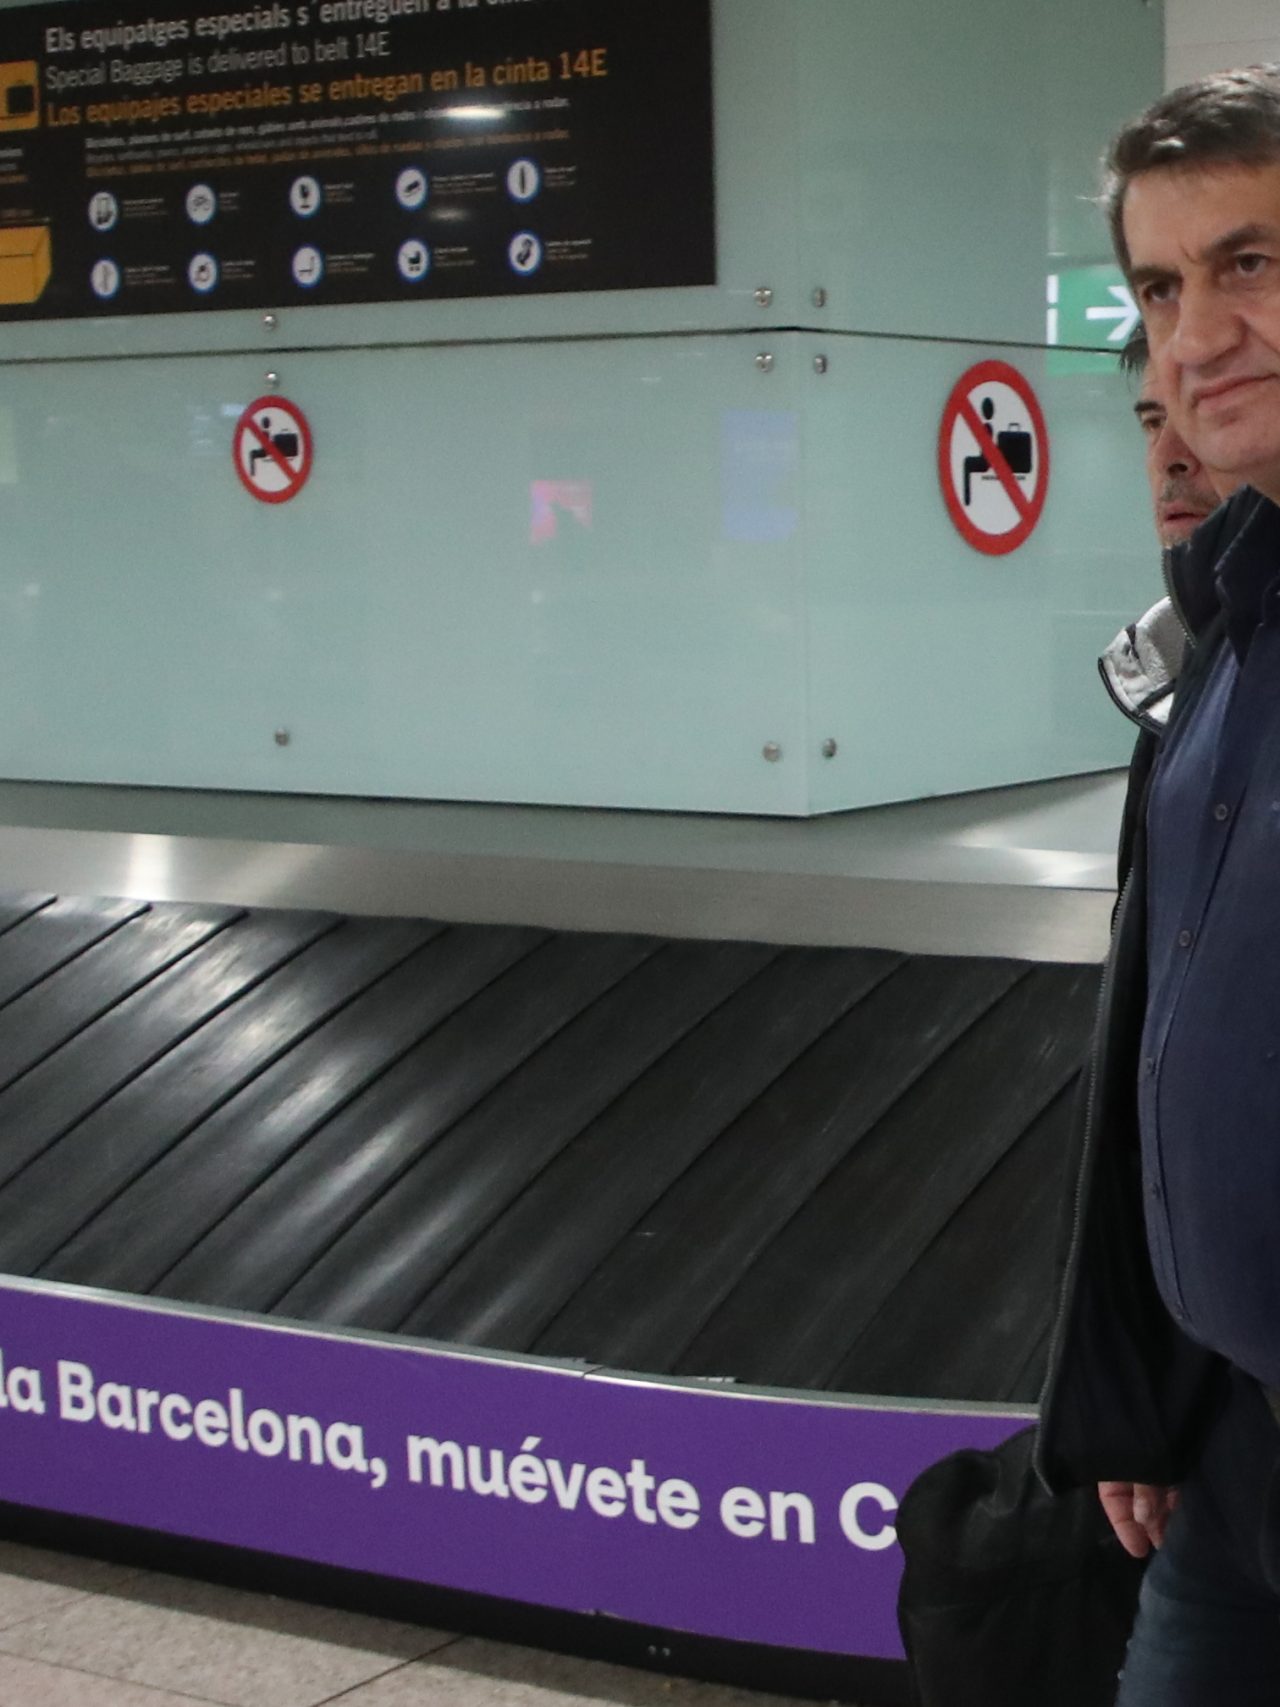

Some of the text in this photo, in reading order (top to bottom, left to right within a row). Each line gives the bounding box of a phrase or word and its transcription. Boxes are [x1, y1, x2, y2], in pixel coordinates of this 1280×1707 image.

[45, 27, 75, 53] Els
[80, 17, 190, 52] equipatges
[195, 4, 290, 39] especials
[46, 30, 391, 91] Special Baggage is delivered to belt 14E
[48, 47, 608, 127] Los equipajes especiales se entregan en la cinta 14E
[57, 1359, 388, 1489] Barcelona,
[406, 1435, 701, 1531] muévete
[719, 1485, 816, 1544] en
[839, 1481, 899, 1551] C
